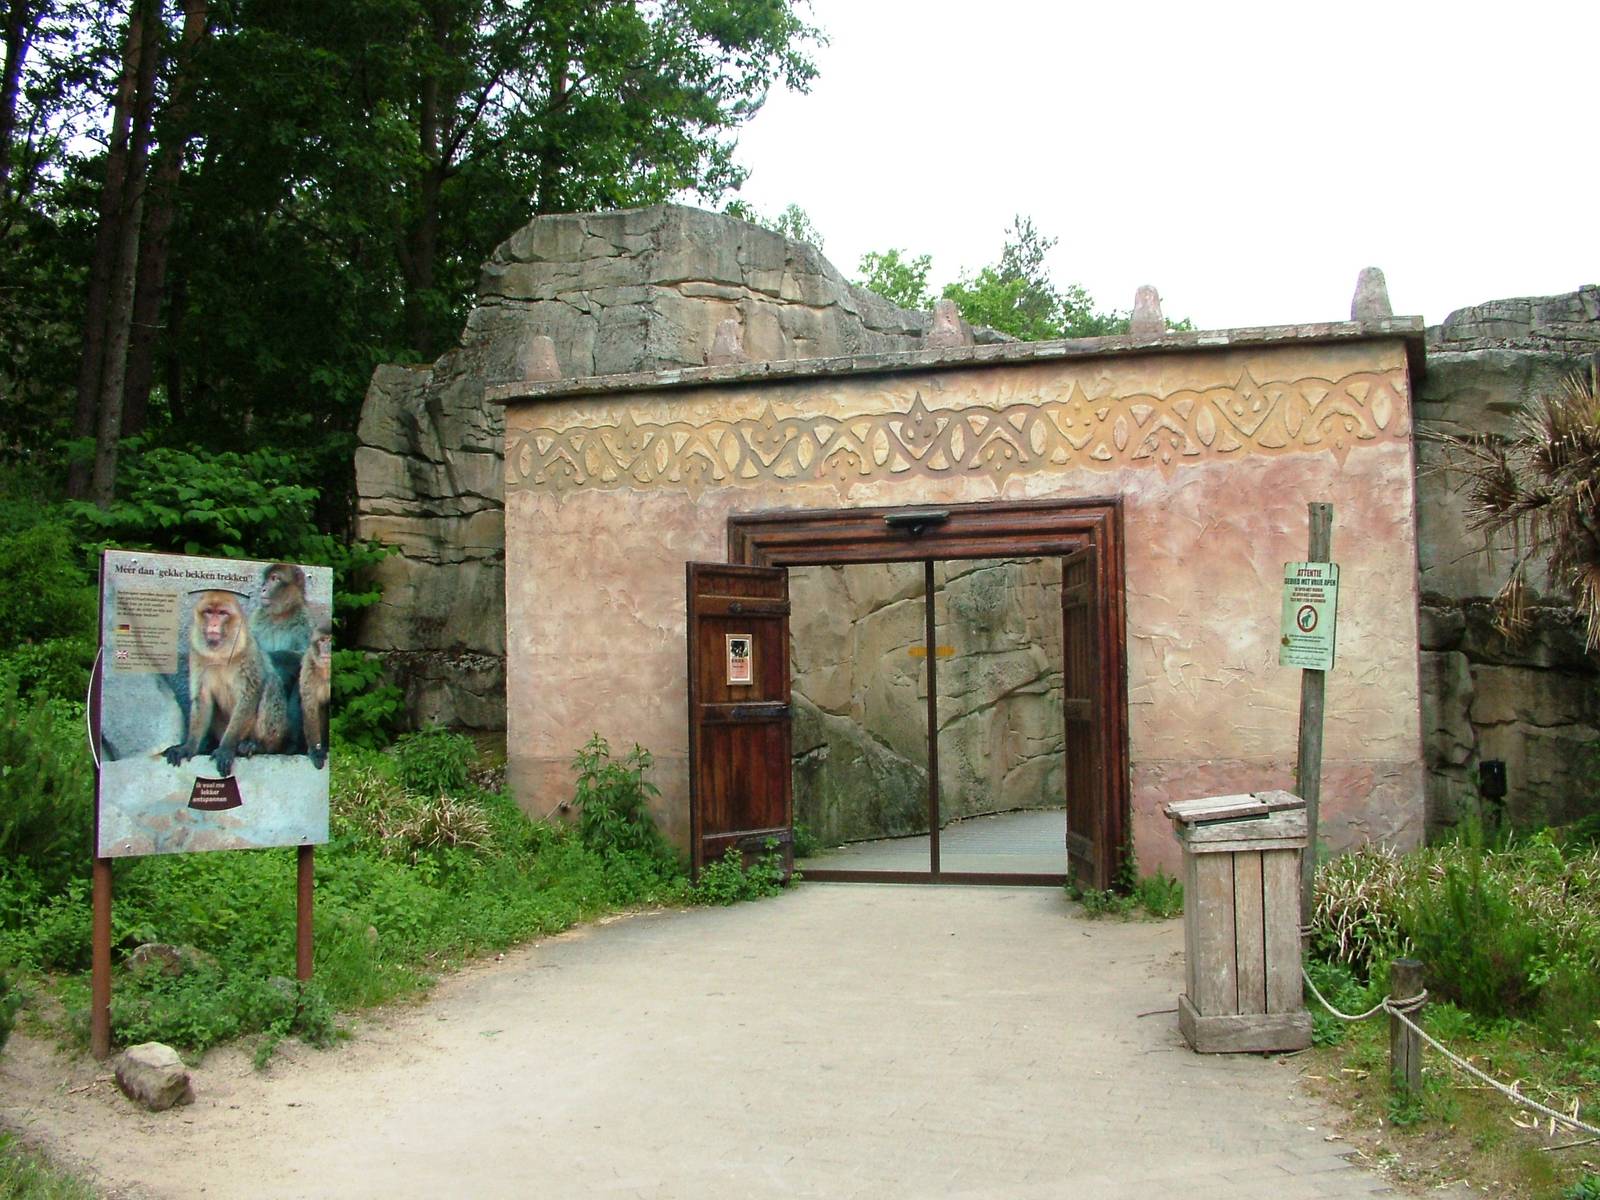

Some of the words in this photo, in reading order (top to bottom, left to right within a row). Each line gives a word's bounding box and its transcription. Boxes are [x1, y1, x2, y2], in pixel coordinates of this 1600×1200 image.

[138, 566, 154, 575] dan
[185, 569, 215, 580] bekken
[1297, 569, 1322, 578] ATTENTIE
[1324, 579, 1336, 587] APEN
